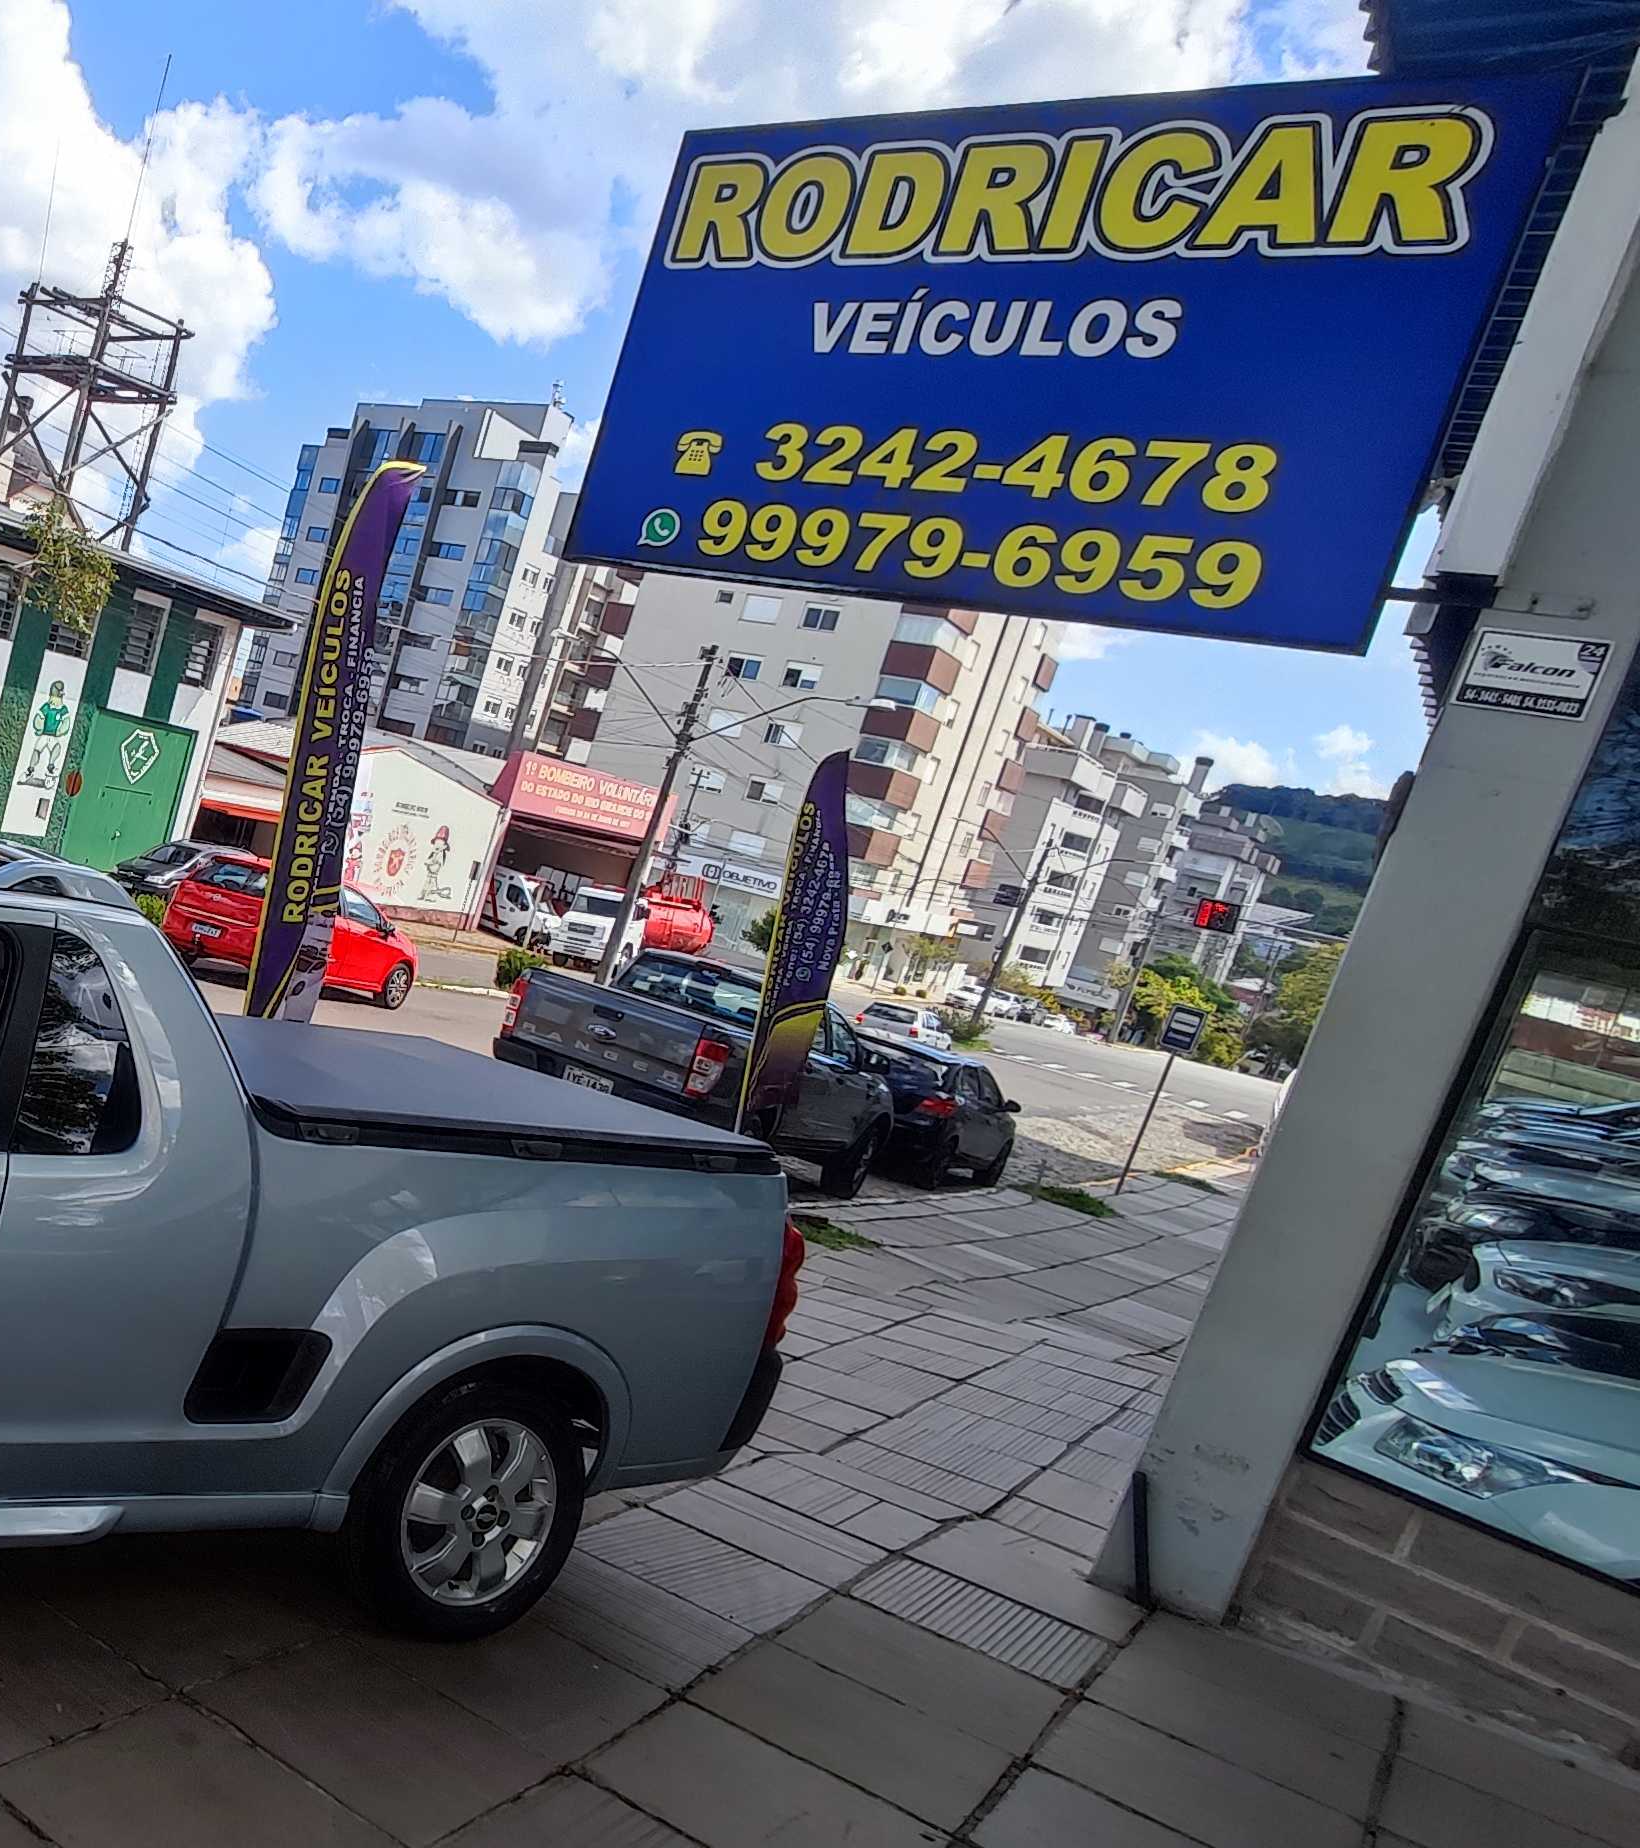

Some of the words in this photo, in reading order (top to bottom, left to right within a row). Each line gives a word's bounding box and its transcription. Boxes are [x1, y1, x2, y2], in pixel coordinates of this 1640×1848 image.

[666, 106, 1492, 266] RODRICAR
[812, 286, 1184, 359] VEÍCULOS
[755, 421, 1278, 515] 3242-4678
[697, 498, 1264, 611] 99979-6959
[338, 683, 354, 748] TROCA
[347, 576, 365, 668] FINANCIA
[1488, 653, 1576, 678] Falcon
[1581, 643, 1606, 658] 24
[282, 754, 329, 923] RODRICAR
[311, 569, 351, 743] VEÍCULOS
[330, 785, 353, 827] (54)
[342, 647, 375, 779] 99979-6959
[521, 781, 534, 793] DO
[538, 765, 596, 793] BOMBEIRO
[722, 870, 778, 890] OBJETIVO
[800, 936, 821, 965] (54)
[522, 1021, 679, 1083] RANGER
